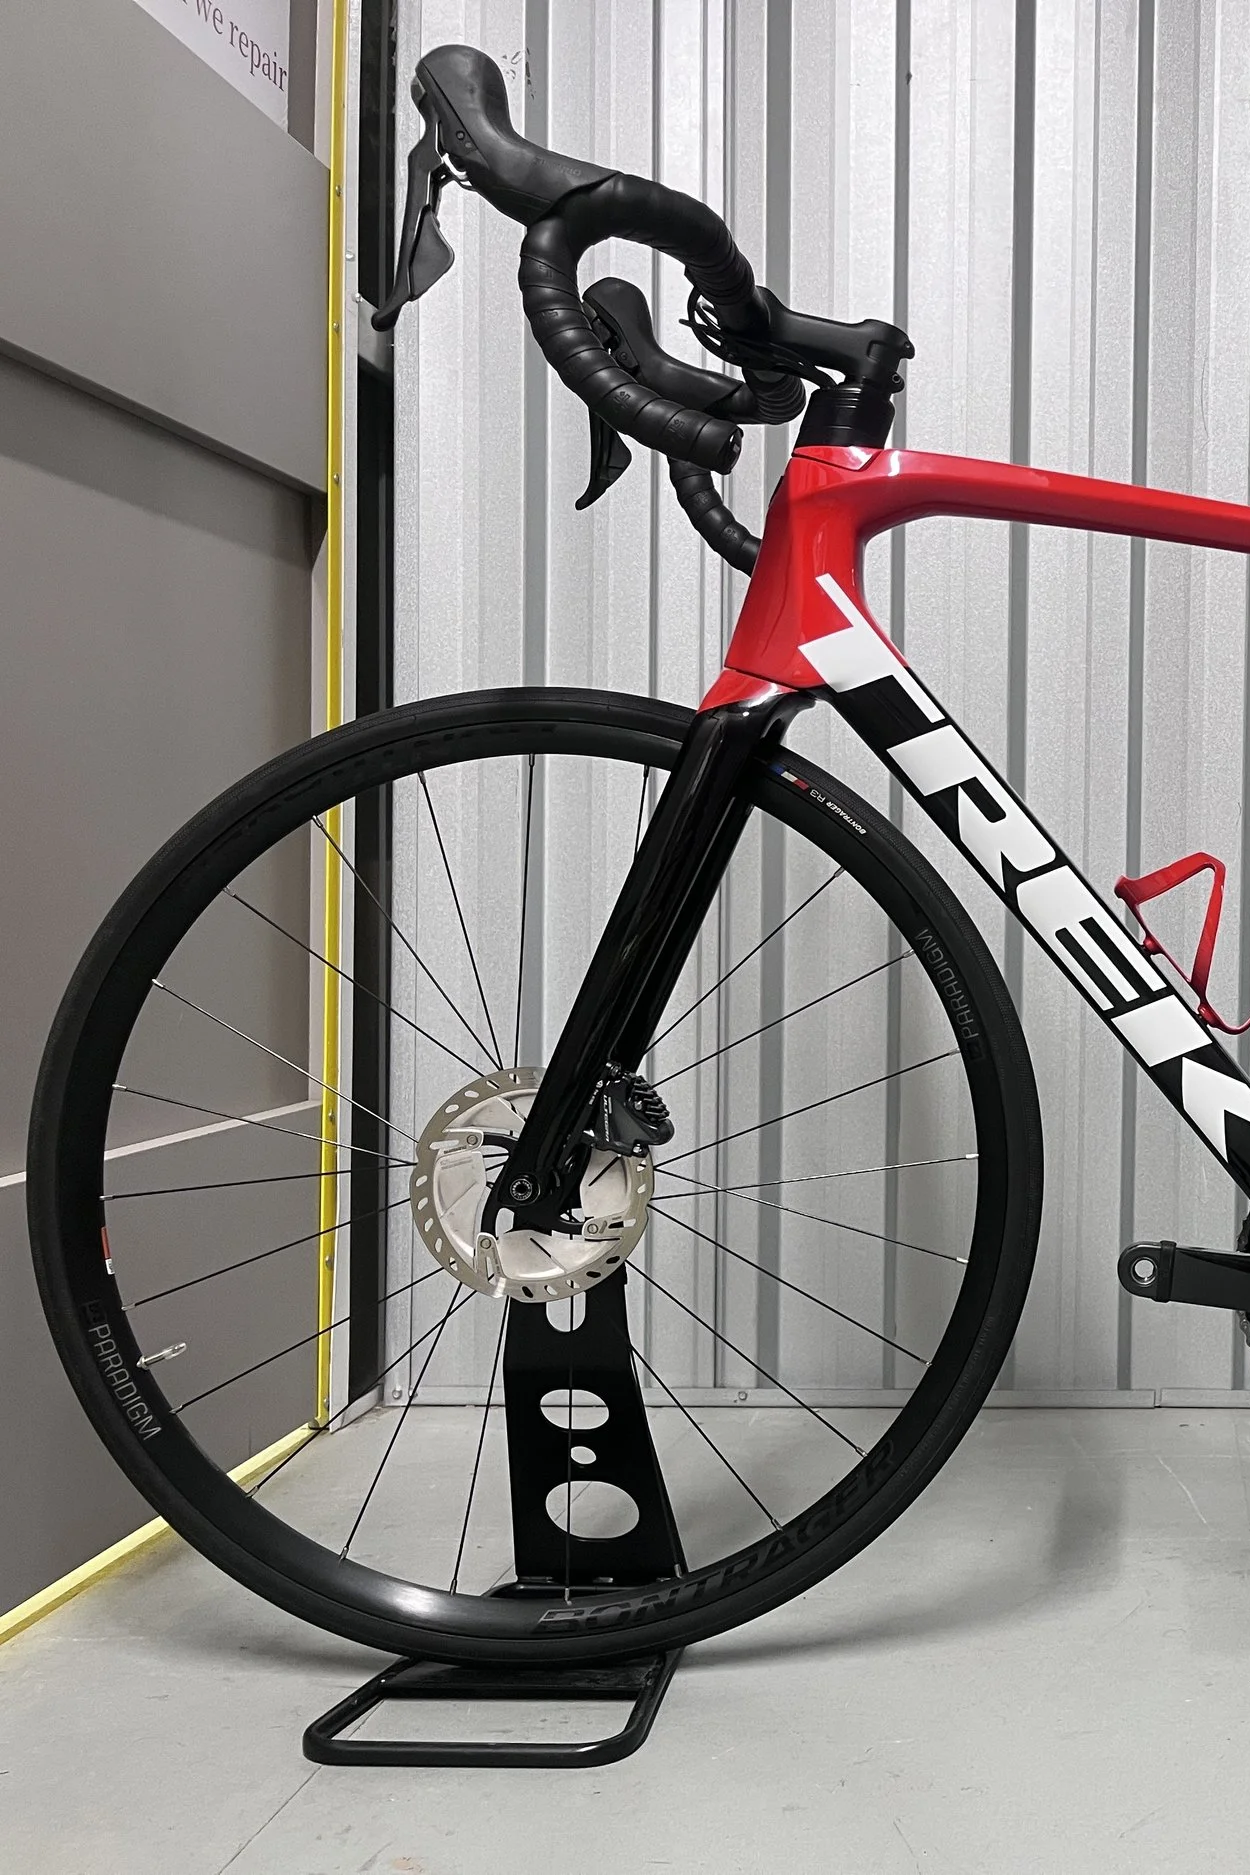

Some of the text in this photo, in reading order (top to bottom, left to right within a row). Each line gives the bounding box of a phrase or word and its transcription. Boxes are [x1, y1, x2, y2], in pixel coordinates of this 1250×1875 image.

[196, 0, 287, 91] we repair
[809, 789, 867, 835] BONTRAGER R3
[914, 928, 980, 1040] PARADIGM
[88, 1323, 162, 1441] PARADIGM
[533, 1438, 895, 1633] BONTRAGER
